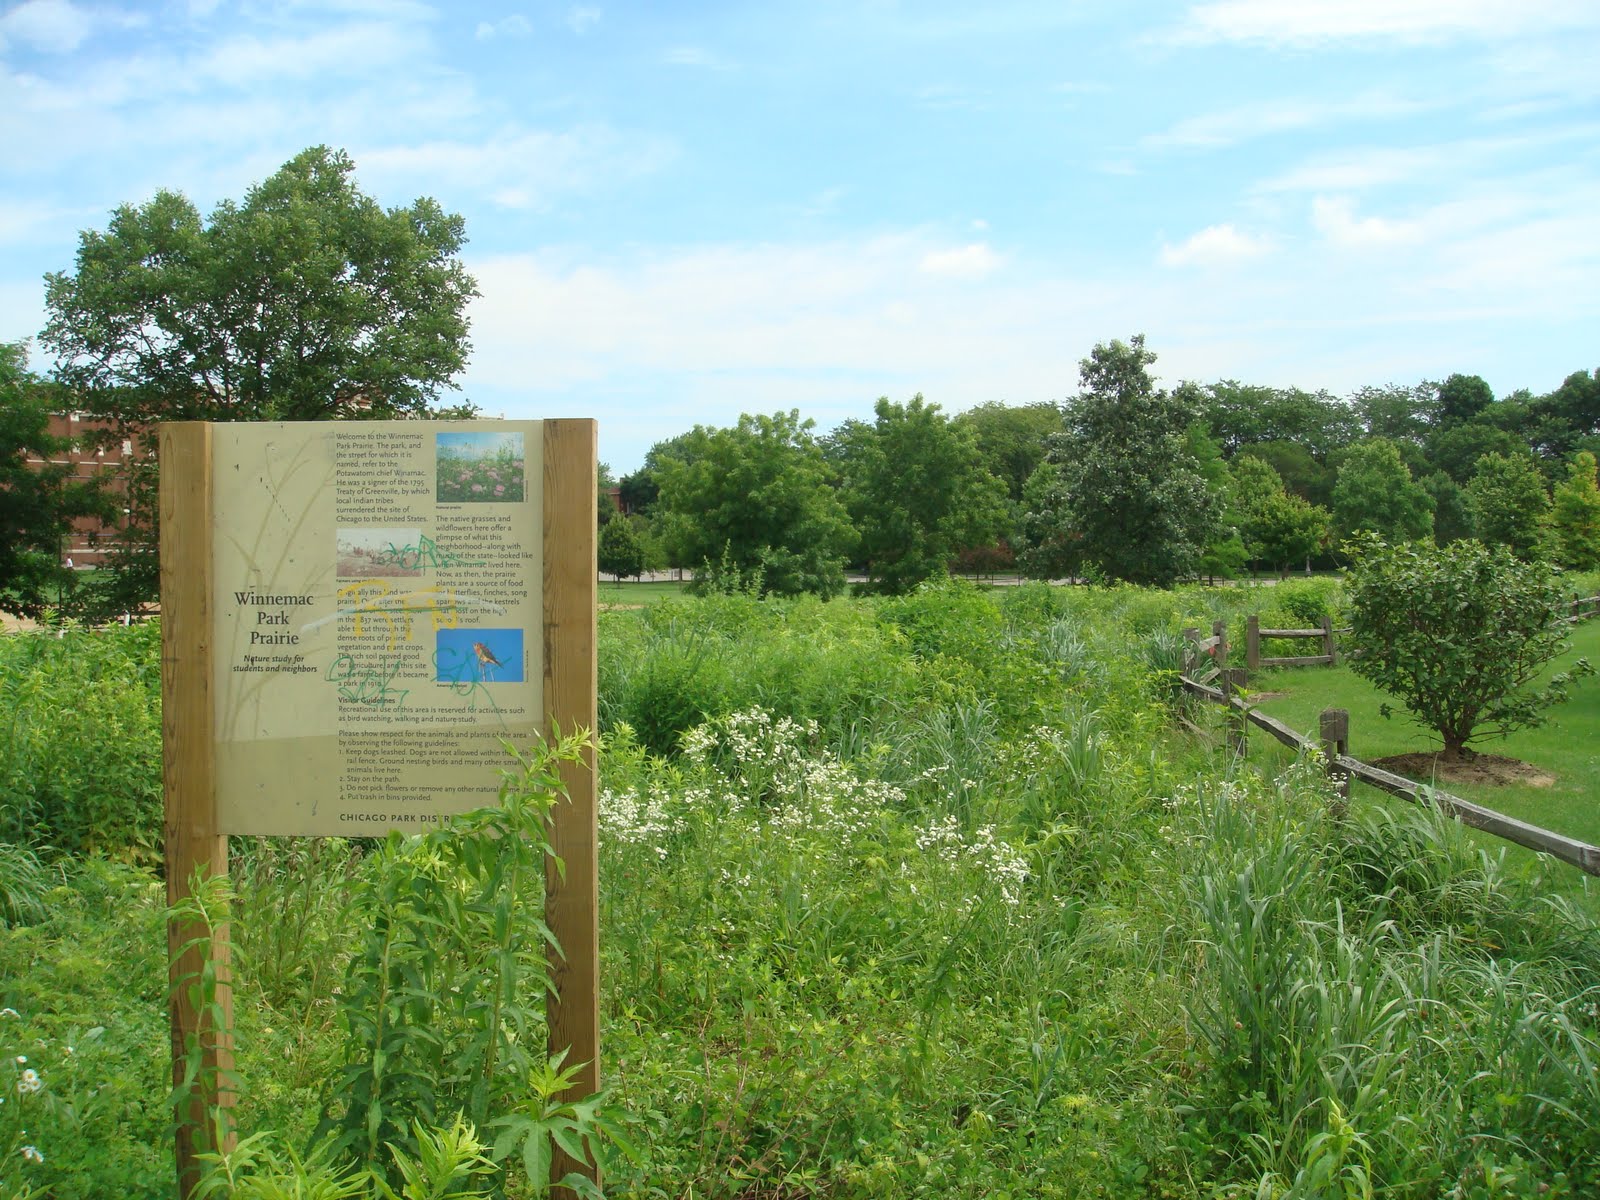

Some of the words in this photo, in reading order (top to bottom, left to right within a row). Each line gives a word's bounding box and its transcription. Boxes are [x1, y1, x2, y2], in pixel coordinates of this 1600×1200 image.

[234, 592, 314, 606] Winnemac
[257, 611, 290, 625] Park
[250, 631, 300, 645] Prairie
[272, 655, 292, 664] study
[293, 655, 304, 664] for
[282, 665, 318, 675] neighbors
[340, 814, 387, 822] CHICAGO
